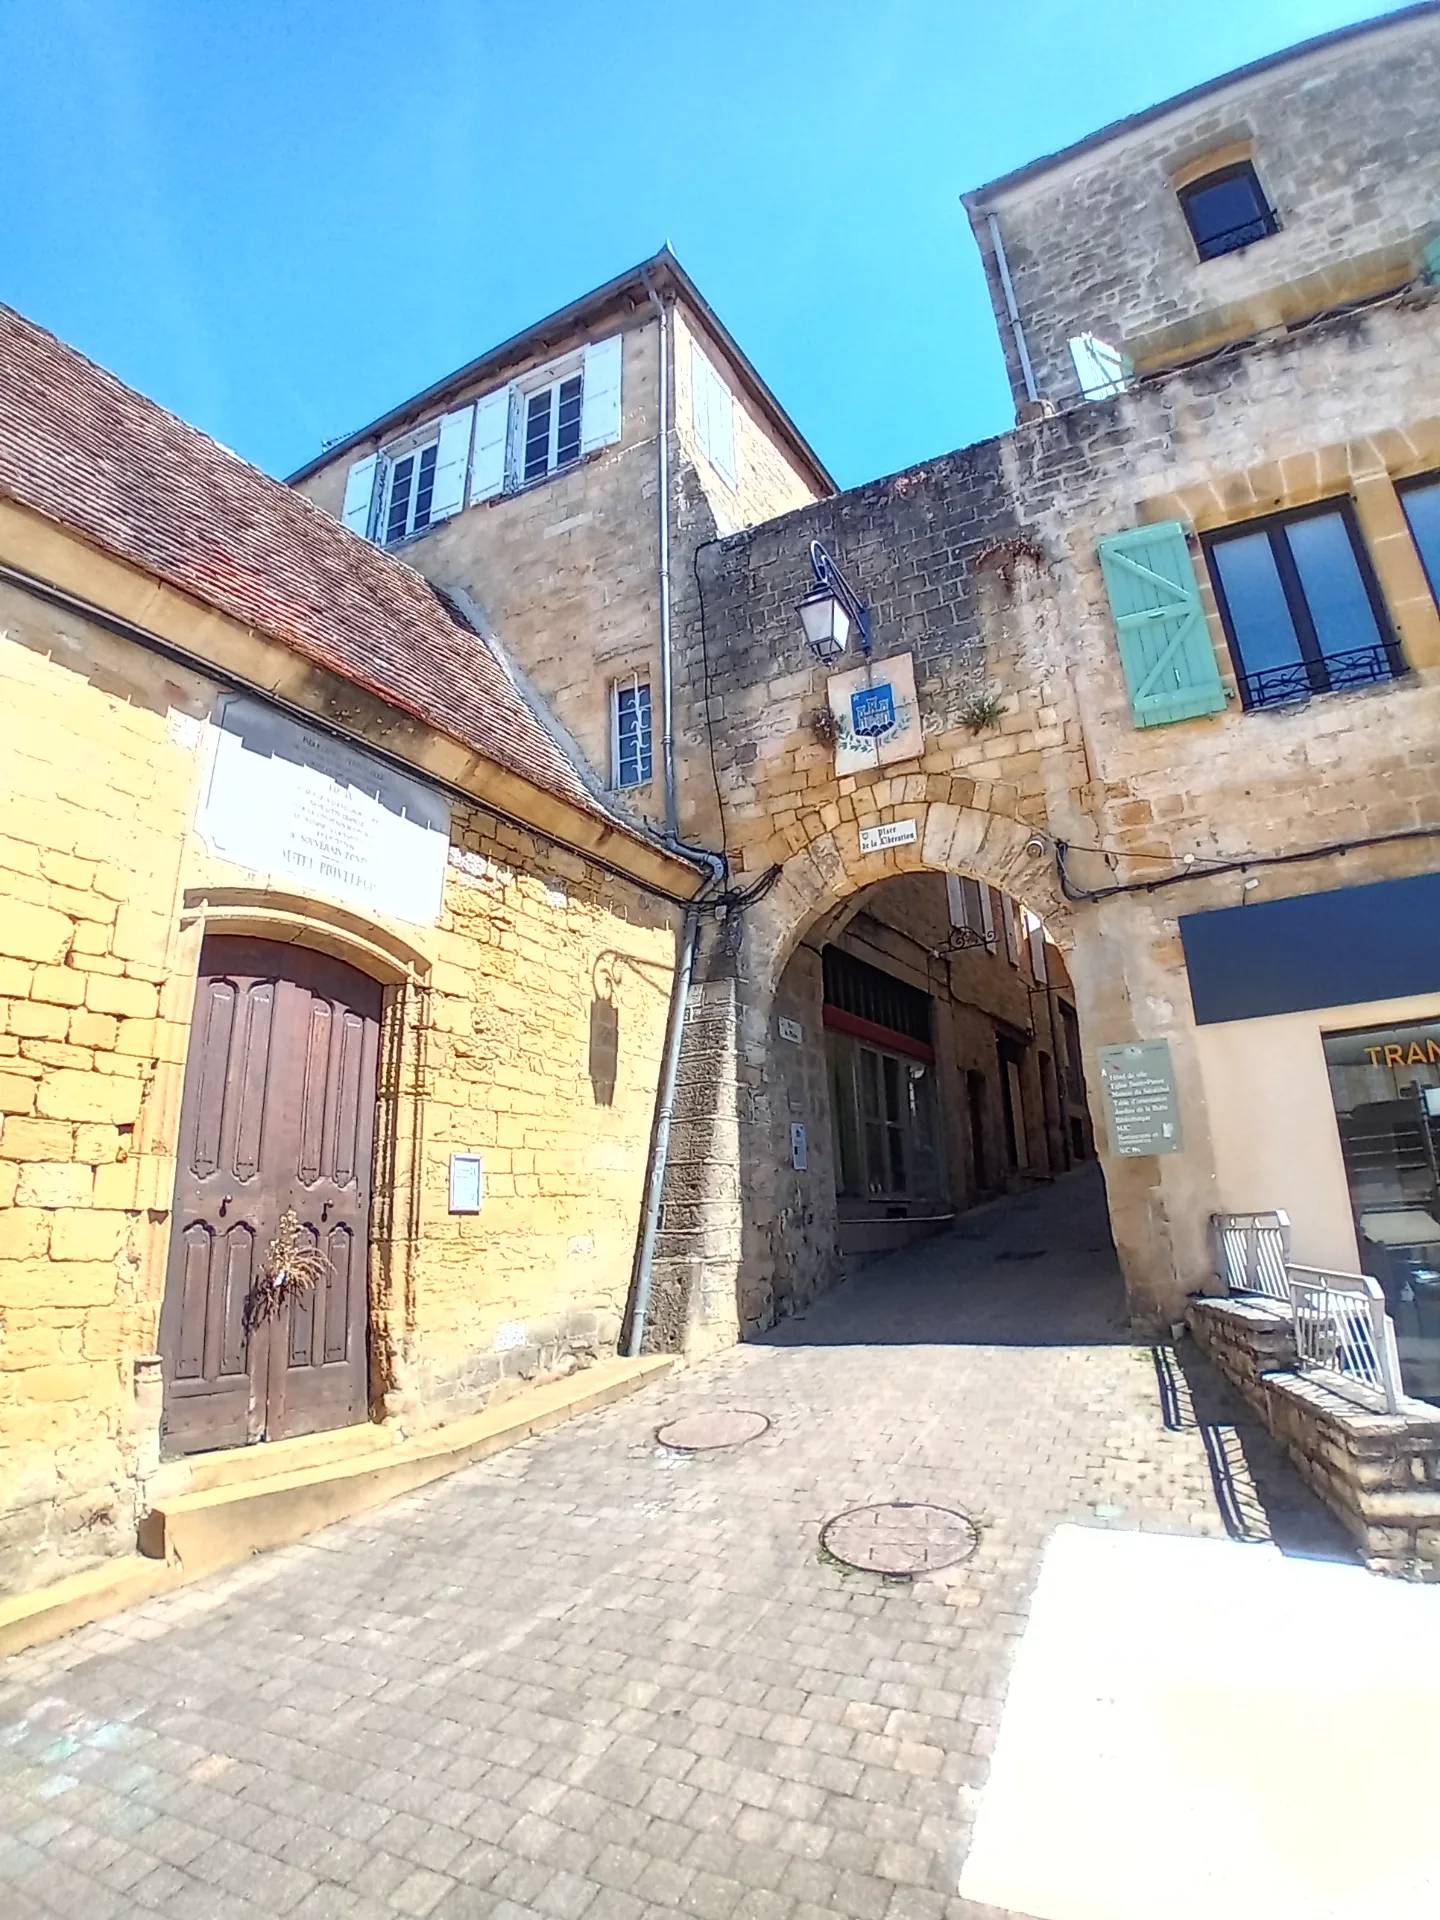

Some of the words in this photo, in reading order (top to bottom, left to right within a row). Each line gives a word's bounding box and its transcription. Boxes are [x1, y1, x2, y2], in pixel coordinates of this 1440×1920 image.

[877, 827, 896, 840] Place
[862, 842, 870, 850] de
[1363, 1039, 1440, 1068] TRAN
